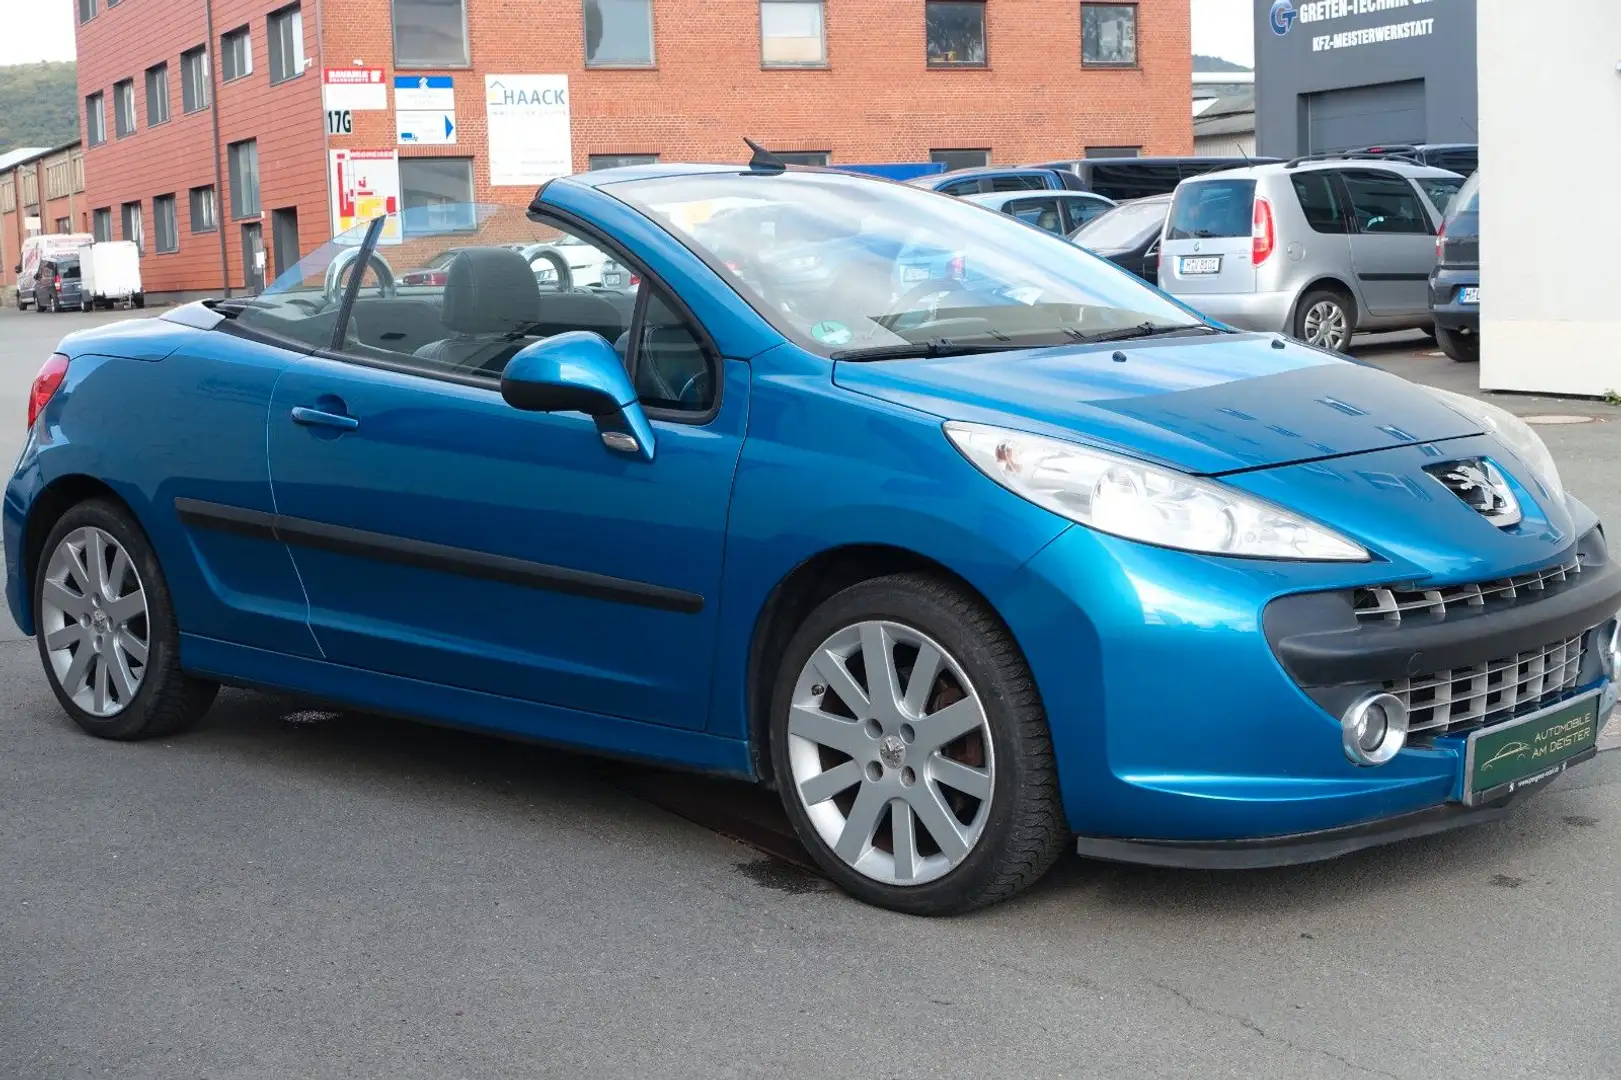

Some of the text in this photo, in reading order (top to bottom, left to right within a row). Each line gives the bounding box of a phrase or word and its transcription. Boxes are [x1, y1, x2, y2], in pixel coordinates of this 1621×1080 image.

[1312, 18, 1434, 51] KFZ-MEISTERWERKSTATT
[503, 89, 566, 105] HAACK
[328, 110, 352, 133] 17G
[1534, 712, 1592, 743] AUTOMOBILE
[1531, 727, 1591, 760] AM DEISTER
